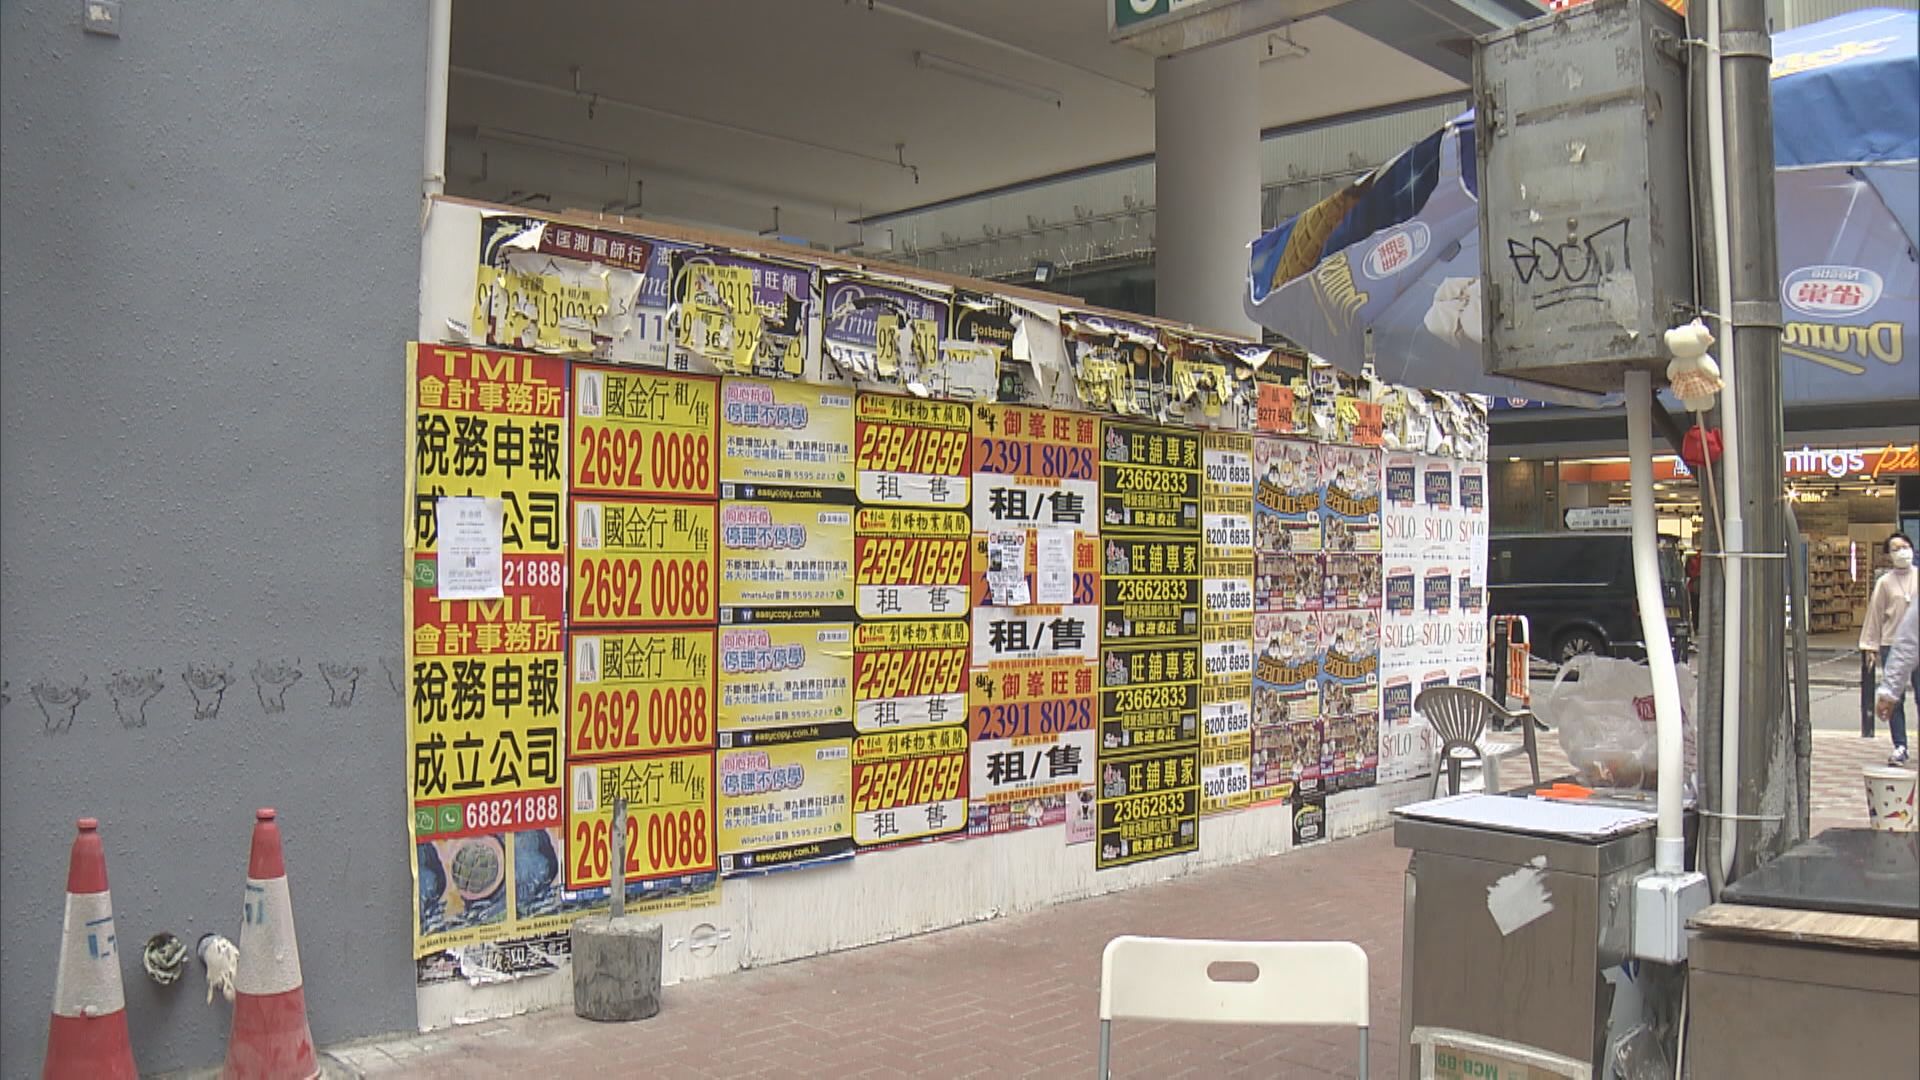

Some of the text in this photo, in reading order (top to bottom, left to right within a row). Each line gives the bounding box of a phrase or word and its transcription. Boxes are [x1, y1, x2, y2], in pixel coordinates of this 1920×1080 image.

[434, 349, 547, 385] TML
[419, 375, 561, 416] 會計事務所
[605, 374, 709, 426] 國金行 租/售
[727, 404, 807, 426] 停課不停學
[417, 413, 561, 482] 稅務申報
[579, 425, 710, 490] 2692 0088
[857, 424, 968, 476] 23841838
[980, 439, 1093, 479] 2391 8028
[1131, 433, 1197, 468] 旺舖專家
[1784, 445, 1864, 478] nings
[876, 475, 950, 502] 租 售
[1116, 467, 1188, 493] 23662833
[1206, 464, 1250, 483] 8200 6835
[757, 487, 823, 500] easycopy.com.hk
[989, 487, 1085, 524] 租/售
[604, 505, 708, 551] 國金行 租/售
[726, 526, 806, 547] 停課不停學
[1206, 528, 1250, 545] 8200 6835
[1386, 515, 1416, 540] SOLO
[1424, 517, 1453, 542] SOLO
[503, 560, 561, 587] 21888
[857, 538, 967, 585] 23841838
[1131, 543, 1197, 574] 旺舖專家
[579, 558, 710, 618] 2692 0088
[876, 587, 950, 613] 租 售
[1117, 580, 1188, 601] 23662833
[1206, 592, 1251, 609] 8200 6835
[429, 594, 546, 622] TML
[755, 609, 821, 622] easycopy.com.hk
[413, 621, 561, 654] 會計事務所
[989, 618, 1086, 654] 租/售
[1384, 624, 1414, 648] SOLO
[1422, 622, 1451, 646] SOLO
[1457, 621, 1483, 645] SOLO
[602, 636, 708, 681] 國金行 租/售
[724, 649, 805, 670] 停課不停學
[1130, 650, 1196, 683] 旺舖專家
[1206, 657, 1227, 675] 8200
[1229, 654, 1250, 672] 6835
[855, 649, 967, 700] 23841838
[413, 658, 560, 724] 稅務申報
[1115, 686, 1187, 712] 23662833
[576, 687, 708, 751] 2692 0088
[874, 698, 948, 727] 租 售
[978, 702, 1031, 740] 2391
[1040, 697, 1091, 734] 8028
[1205, 714, 1248, 736] 8200 6835
[754, 727, 820, 742] easycopy.com.hk
[1382, 732, 1412, 759] SOLO
[413, 726, 559, 798] 成立公司
[986, 744, 1083, 786] 租/售
[1128, 757, 1195, 793] 旺舖專家
[600, 760, 706, 808] 國金行 租/售
[724, 768, 803, 793] 停課不停學
[854, 755, 964, 813] 23841838
[1204, 775, 1248, 798] 8200 6835
[466, 795, 559, 829] 68821888
[873, 812, 899, 838] 租
[925, 805, 948, 829] 售
[1113, 792, 1185, 822] 23662833
[648, 808, 707, 871] 0088
[756, 844, 821, 863] easycopy.com.hk
